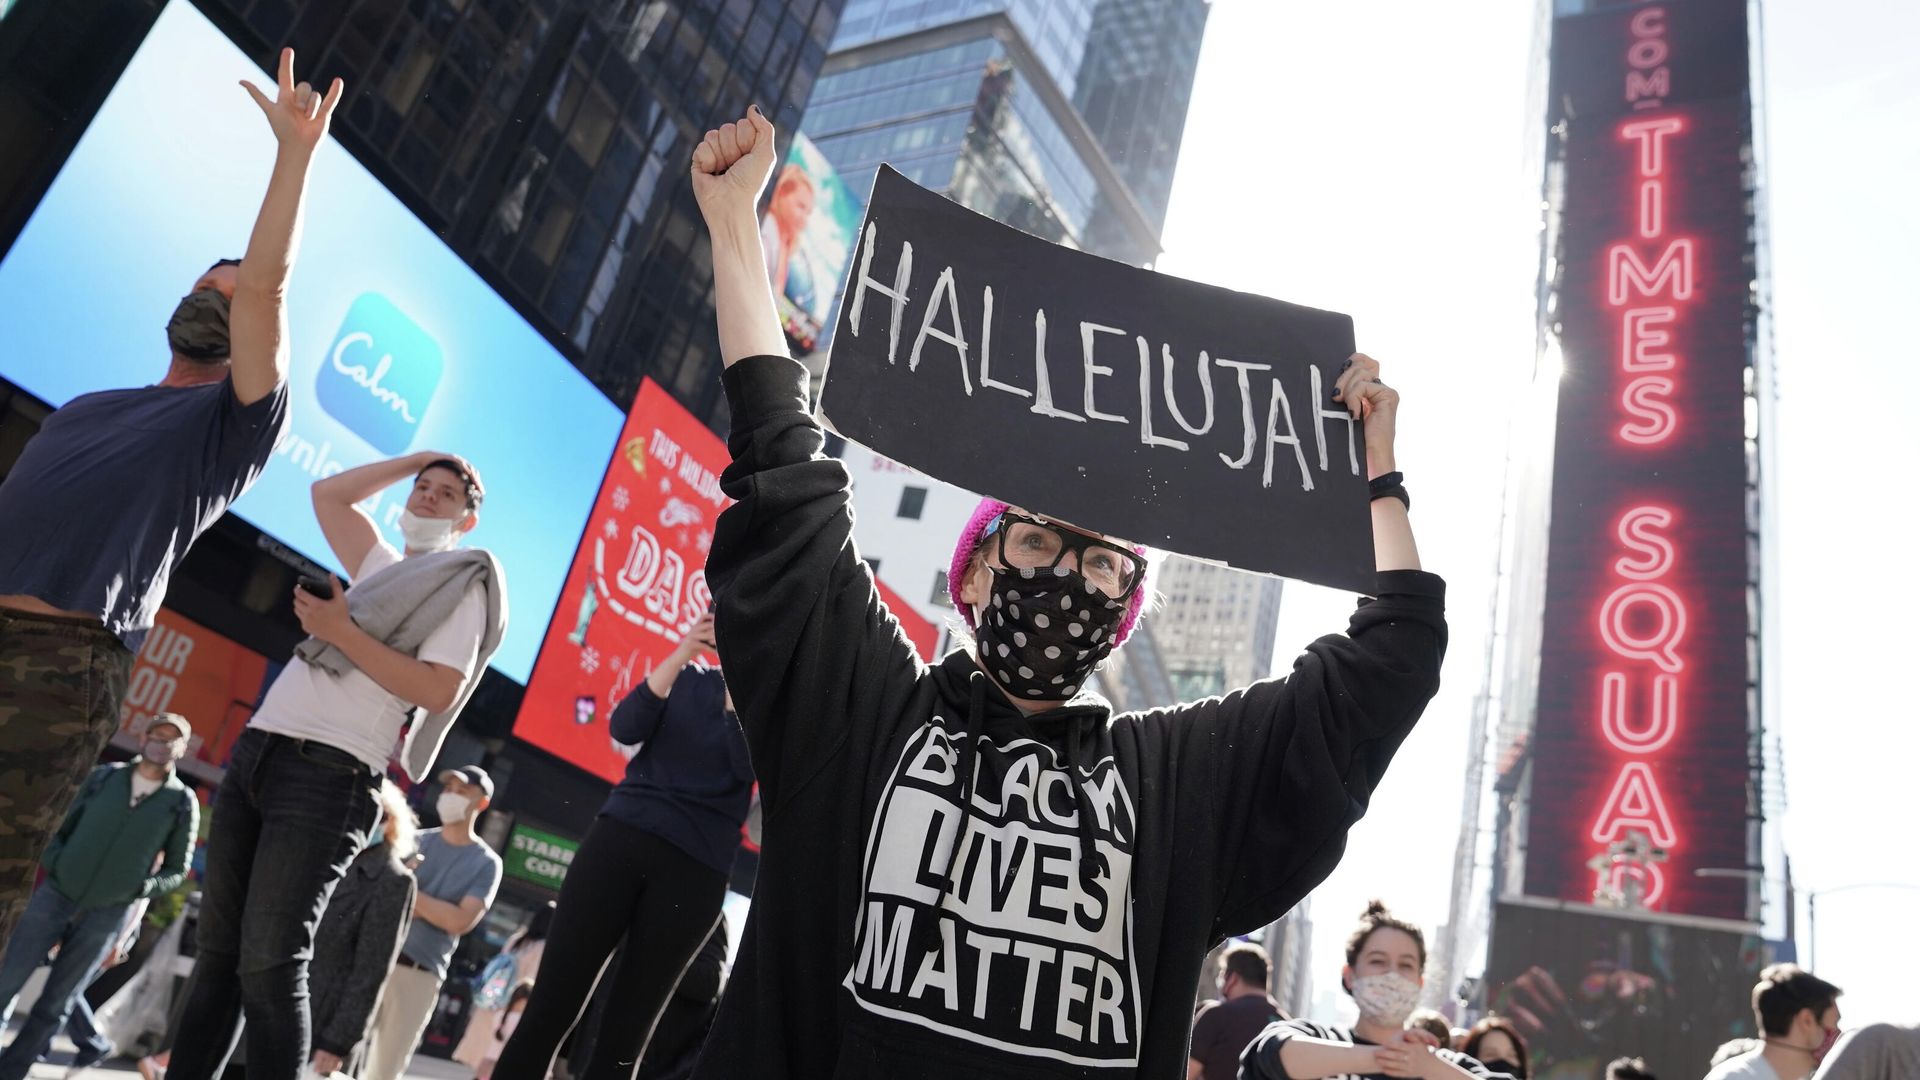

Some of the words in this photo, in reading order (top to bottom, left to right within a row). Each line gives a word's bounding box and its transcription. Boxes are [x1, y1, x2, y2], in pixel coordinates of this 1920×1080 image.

[1608, 117, 1693, 445] TIMES
[331, 330, 417, 426] Calm
[849, 220, 1360, 491] HALLELUJAH
[648, 427, 682, 471] THIS
[904, 726, 1128, 844] BLACK
[915, 809, 1112, 933] LIVES
[854, 900, 1129, 1045] MATTER
